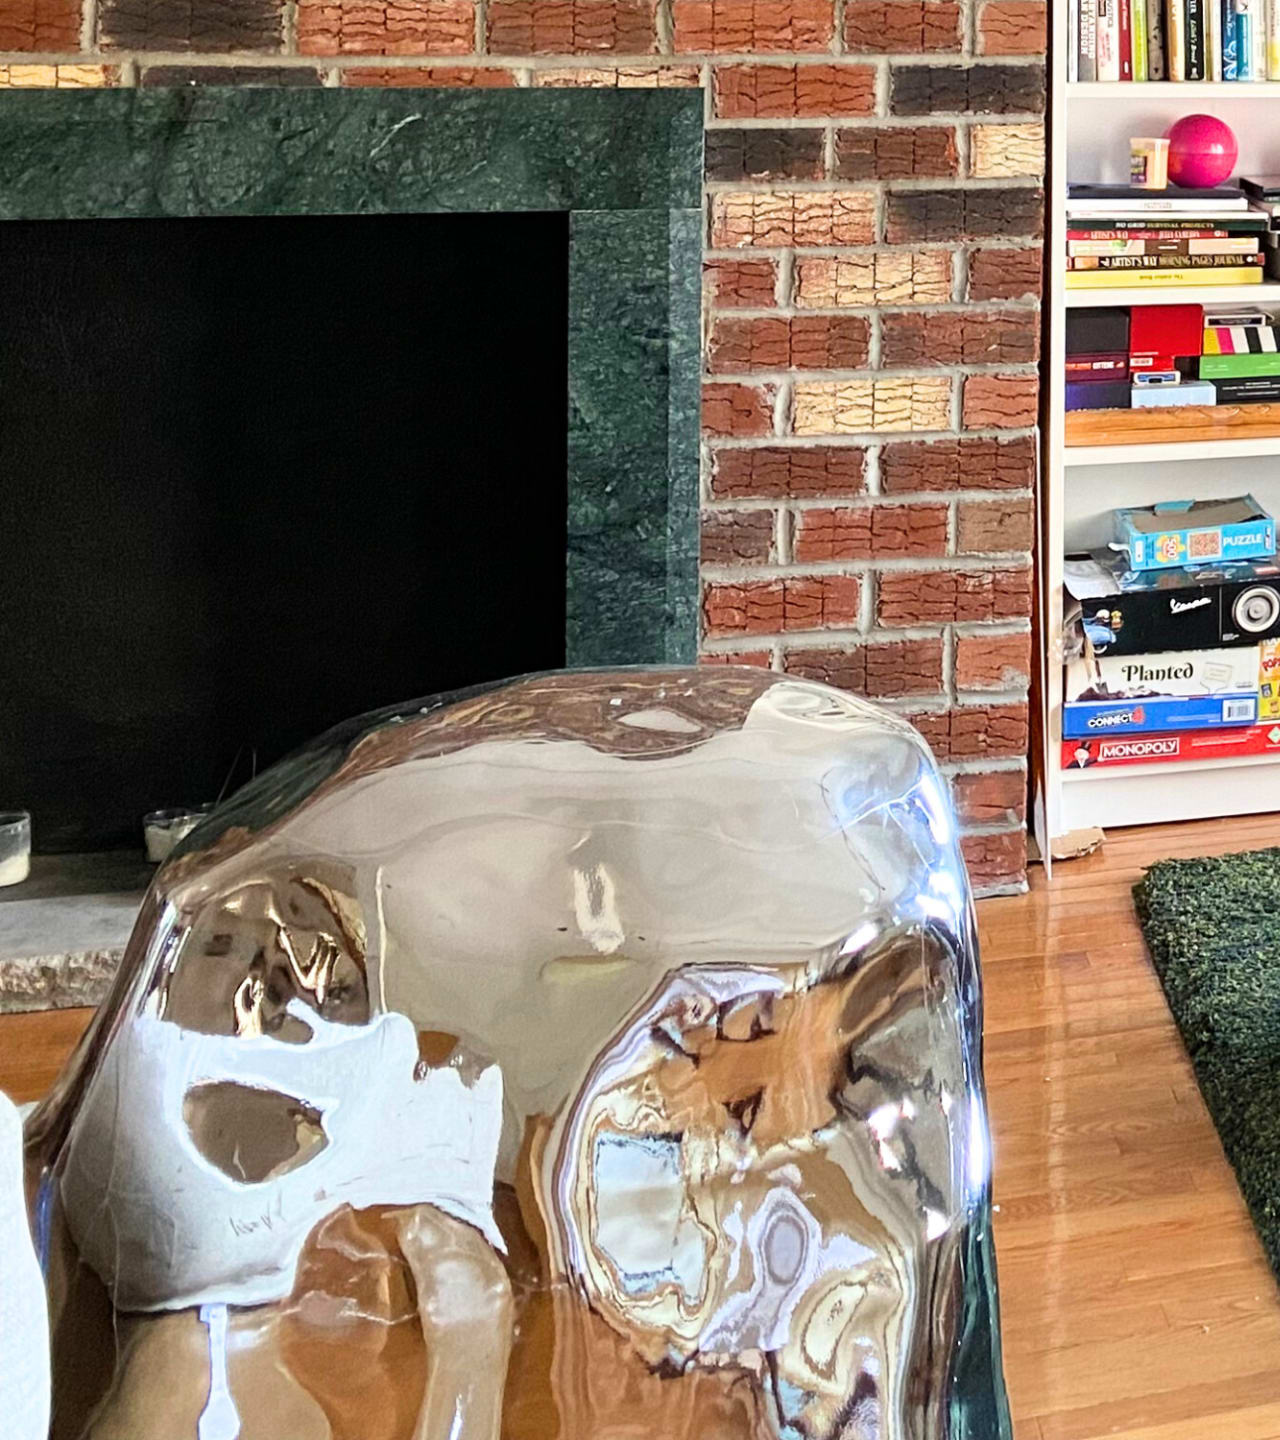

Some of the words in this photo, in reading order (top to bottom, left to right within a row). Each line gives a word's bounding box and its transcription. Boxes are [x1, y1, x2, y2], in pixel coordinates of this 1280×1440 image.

[1111, 256, 1142, 266] ARTIST'S
[1143, 255, 1157, 266] WAY
[1159, 255, 1190, 266] MORNING
[1192, 255, 1212, 265] PAGES
[1213, 254, 1245, 265] JOURNAL
[1223, 532, 1263, 547] PUZZLE
[1121, 661, 1194, 683] Planted
[1087, 713, 1133, 728] CONNECT
[1103, 740, 1177, 758] MONOPOLY
